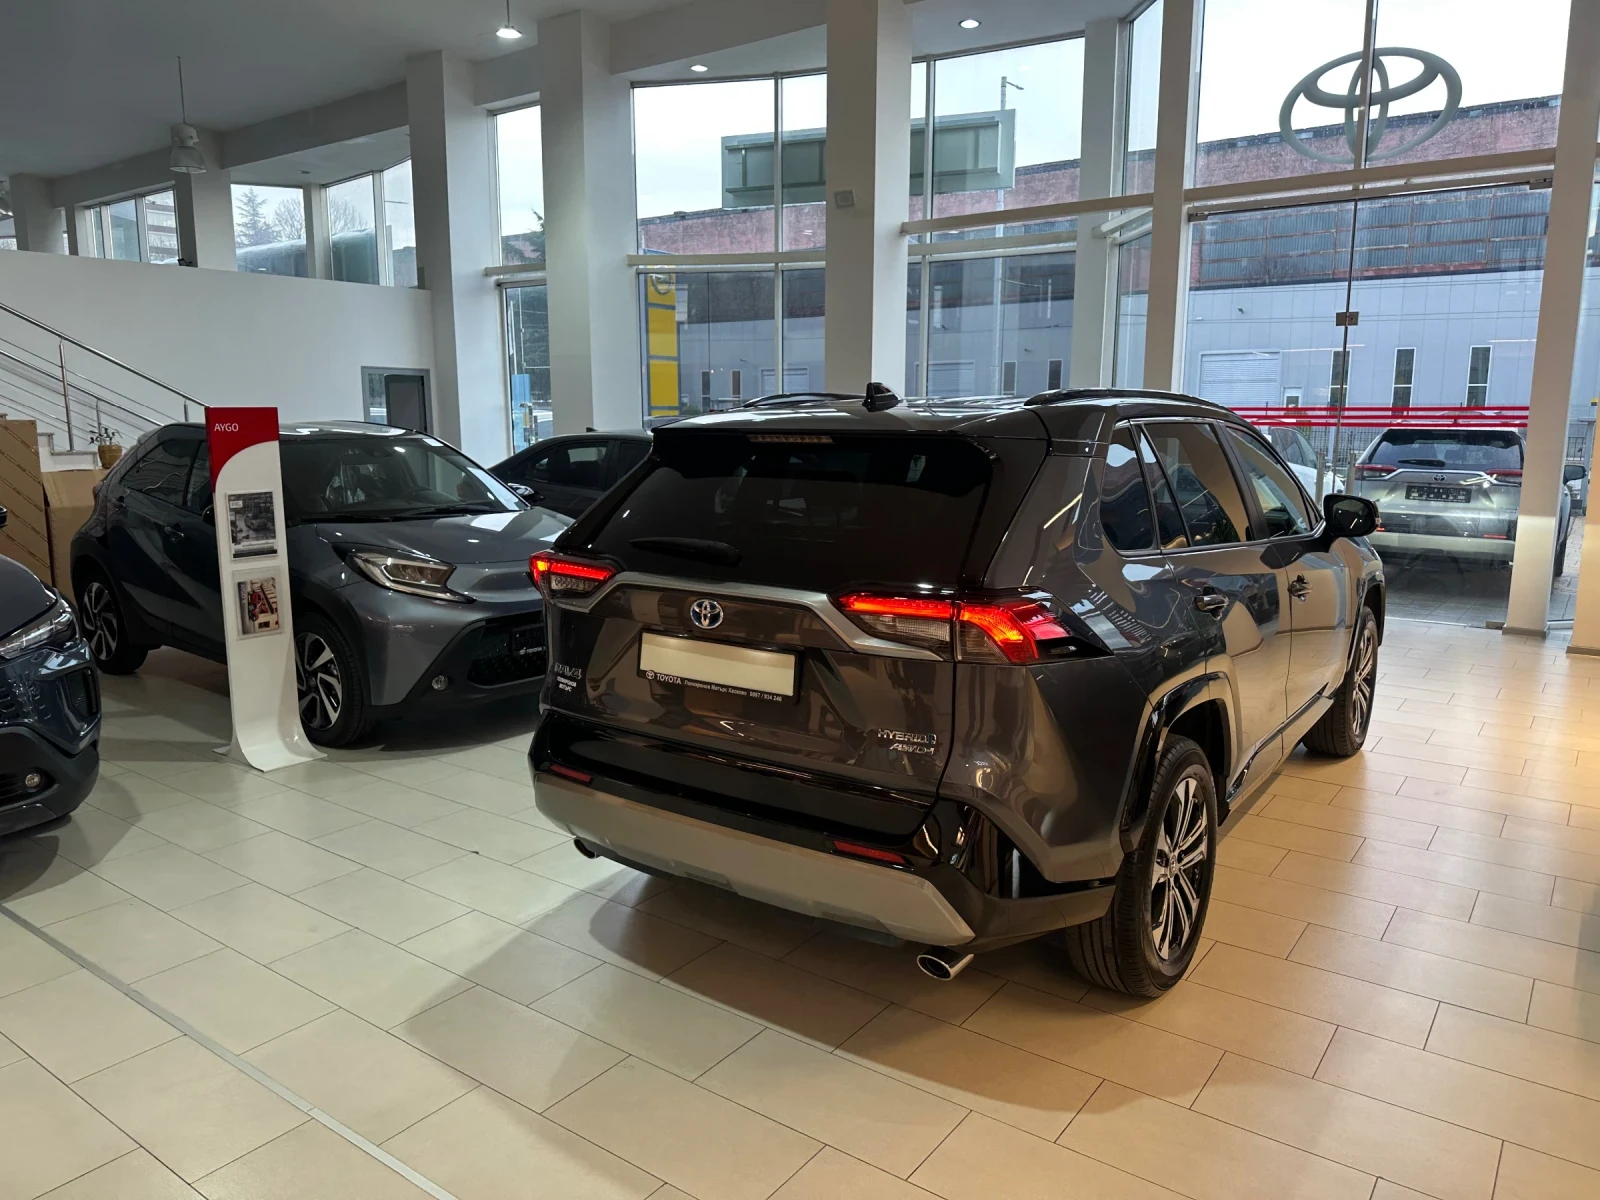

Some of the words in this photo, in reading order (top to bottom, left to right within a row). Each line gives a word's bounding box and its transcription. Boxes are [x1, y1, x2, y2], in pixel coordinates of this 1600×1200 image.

[214, 423, 239, 432] AYGO
[554, 662, 582, 680] RAV4
[656, 673, 682, 685] TOYOTA
